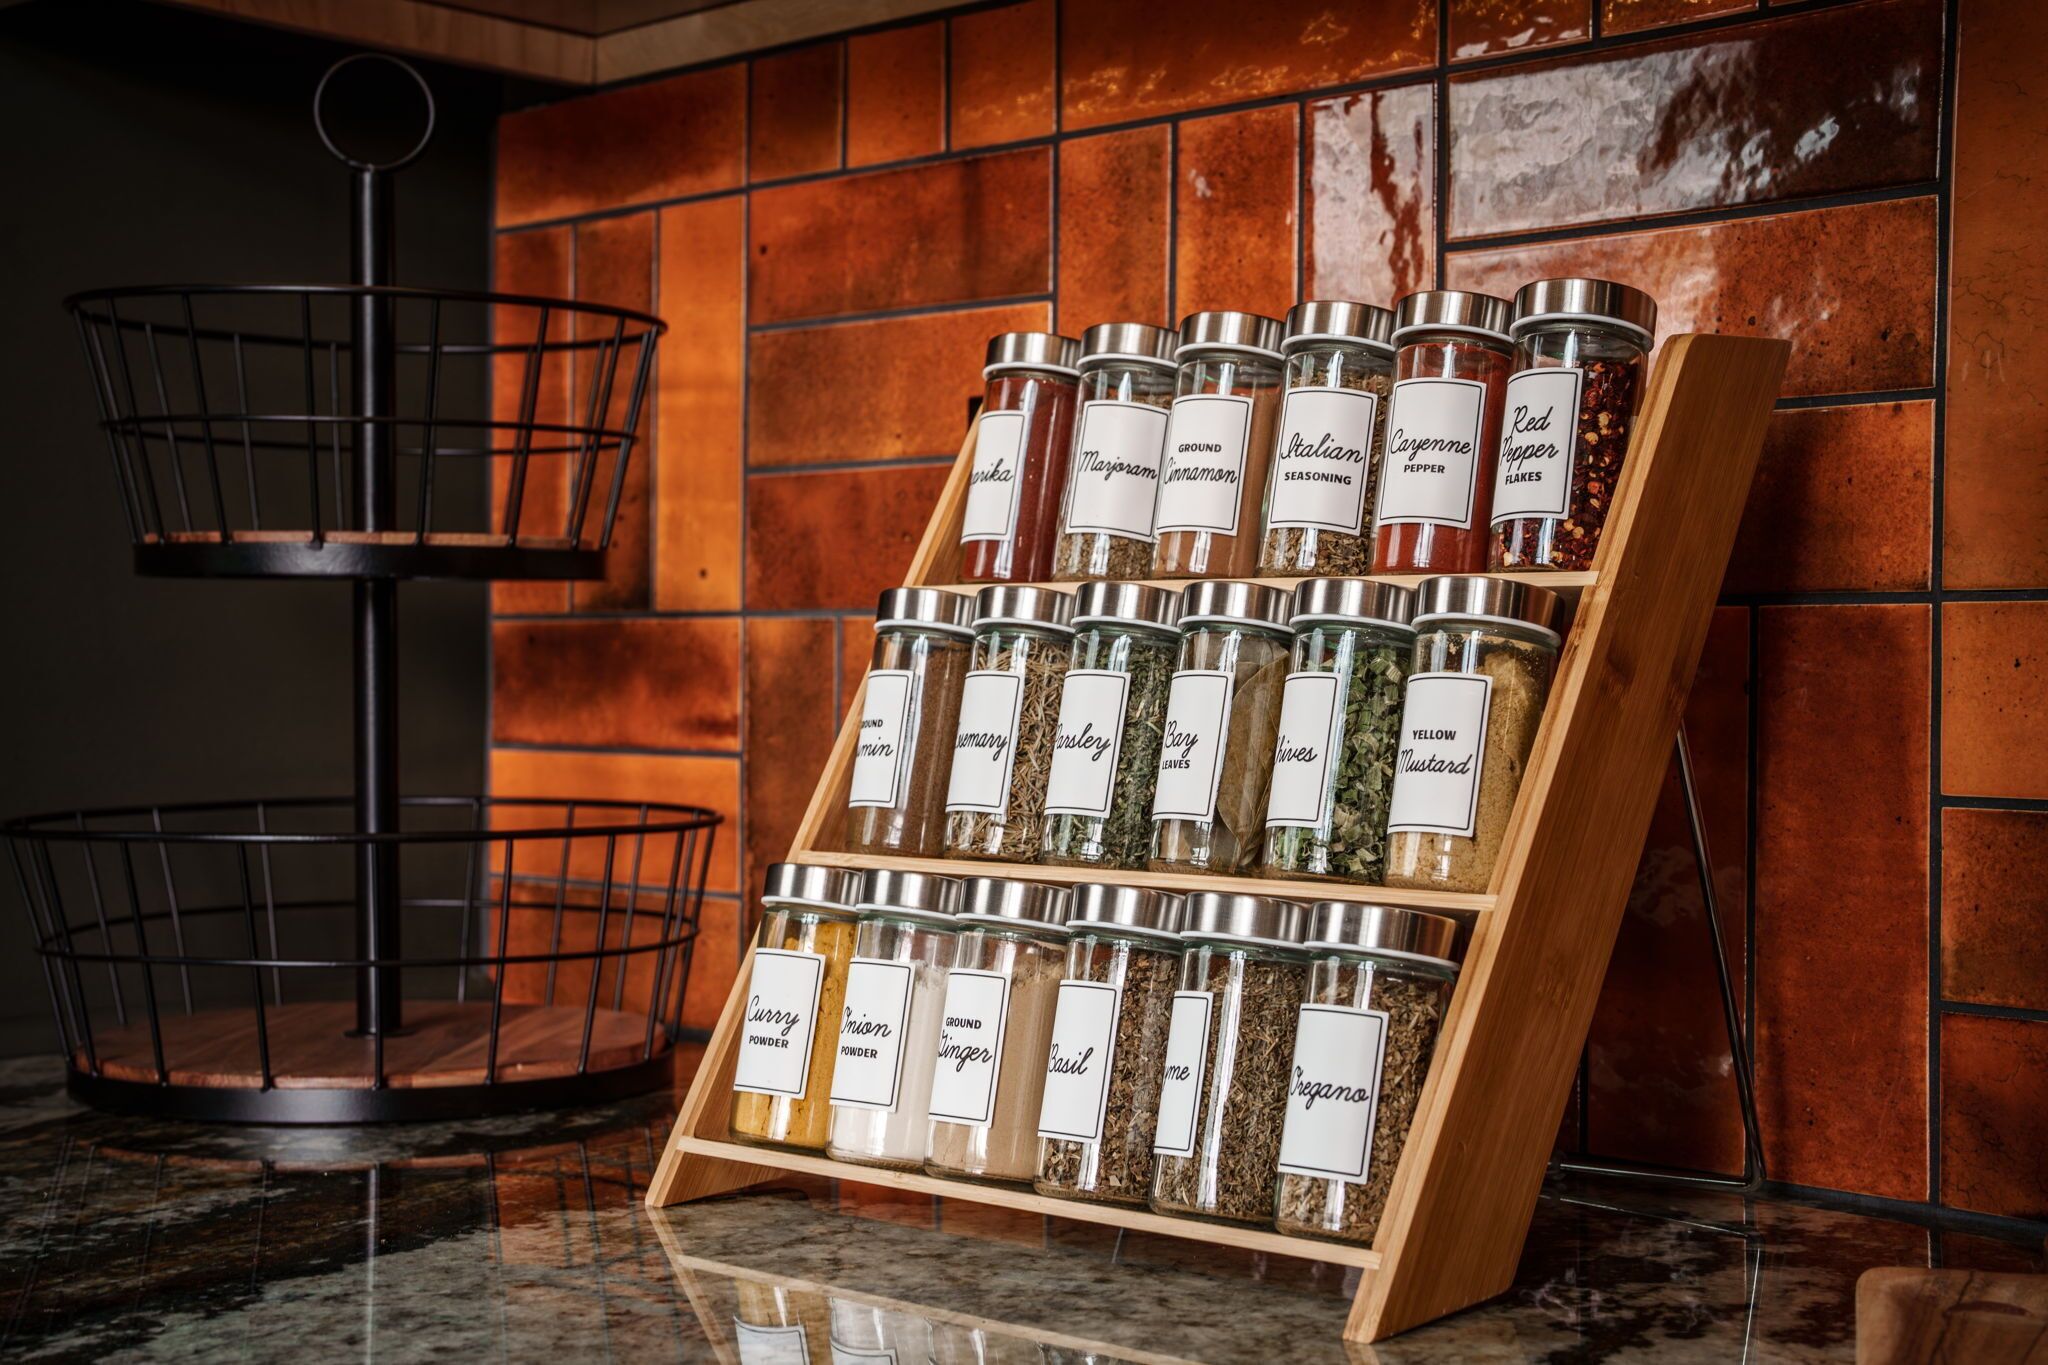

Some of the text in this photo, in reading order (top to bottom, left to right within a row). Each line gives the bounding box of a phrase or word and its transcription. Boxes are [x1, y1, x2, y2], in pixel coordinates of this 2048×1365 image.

[1513, 405, 1554, 433] Red
[1178, 444, 1222, 453] GROUND
[1281, 432, 1364, 463] Italian
[1390, 429, 1472, 461] Cayenne
[1501, 437, 1559, 471] Pepper
[1080, 450, 1158, 481] Marjoram
[1163, 457, 1237, 486] Cinnamon
[1284, 471, 1352, 485] SEASONING
[1404, 464, 1445, 474] PEPPER
[1505, 471, 1542, 485] FLAKES
[1164, 720, 1199, 757] Bay
[1412, 729, 1457, 741] YELLOW
[1275, 735, 1319, 765] hives
[1398, 750, 1472, 775] Mustard
[1162, 759, 1191, 770] LEAVES
[747, 995, 801, 1036] Curry
[840, 1006, 893, 1038] Onion
[945, 1017, 982, 1030] GROUND
[748, 1035, 789, 1049] POWDER
[841, 1046, 878, 1059] POWDER
[1048, 1043, 1094, 1076] Basil
[1289, 1065, 1370, 1110] Oregano
